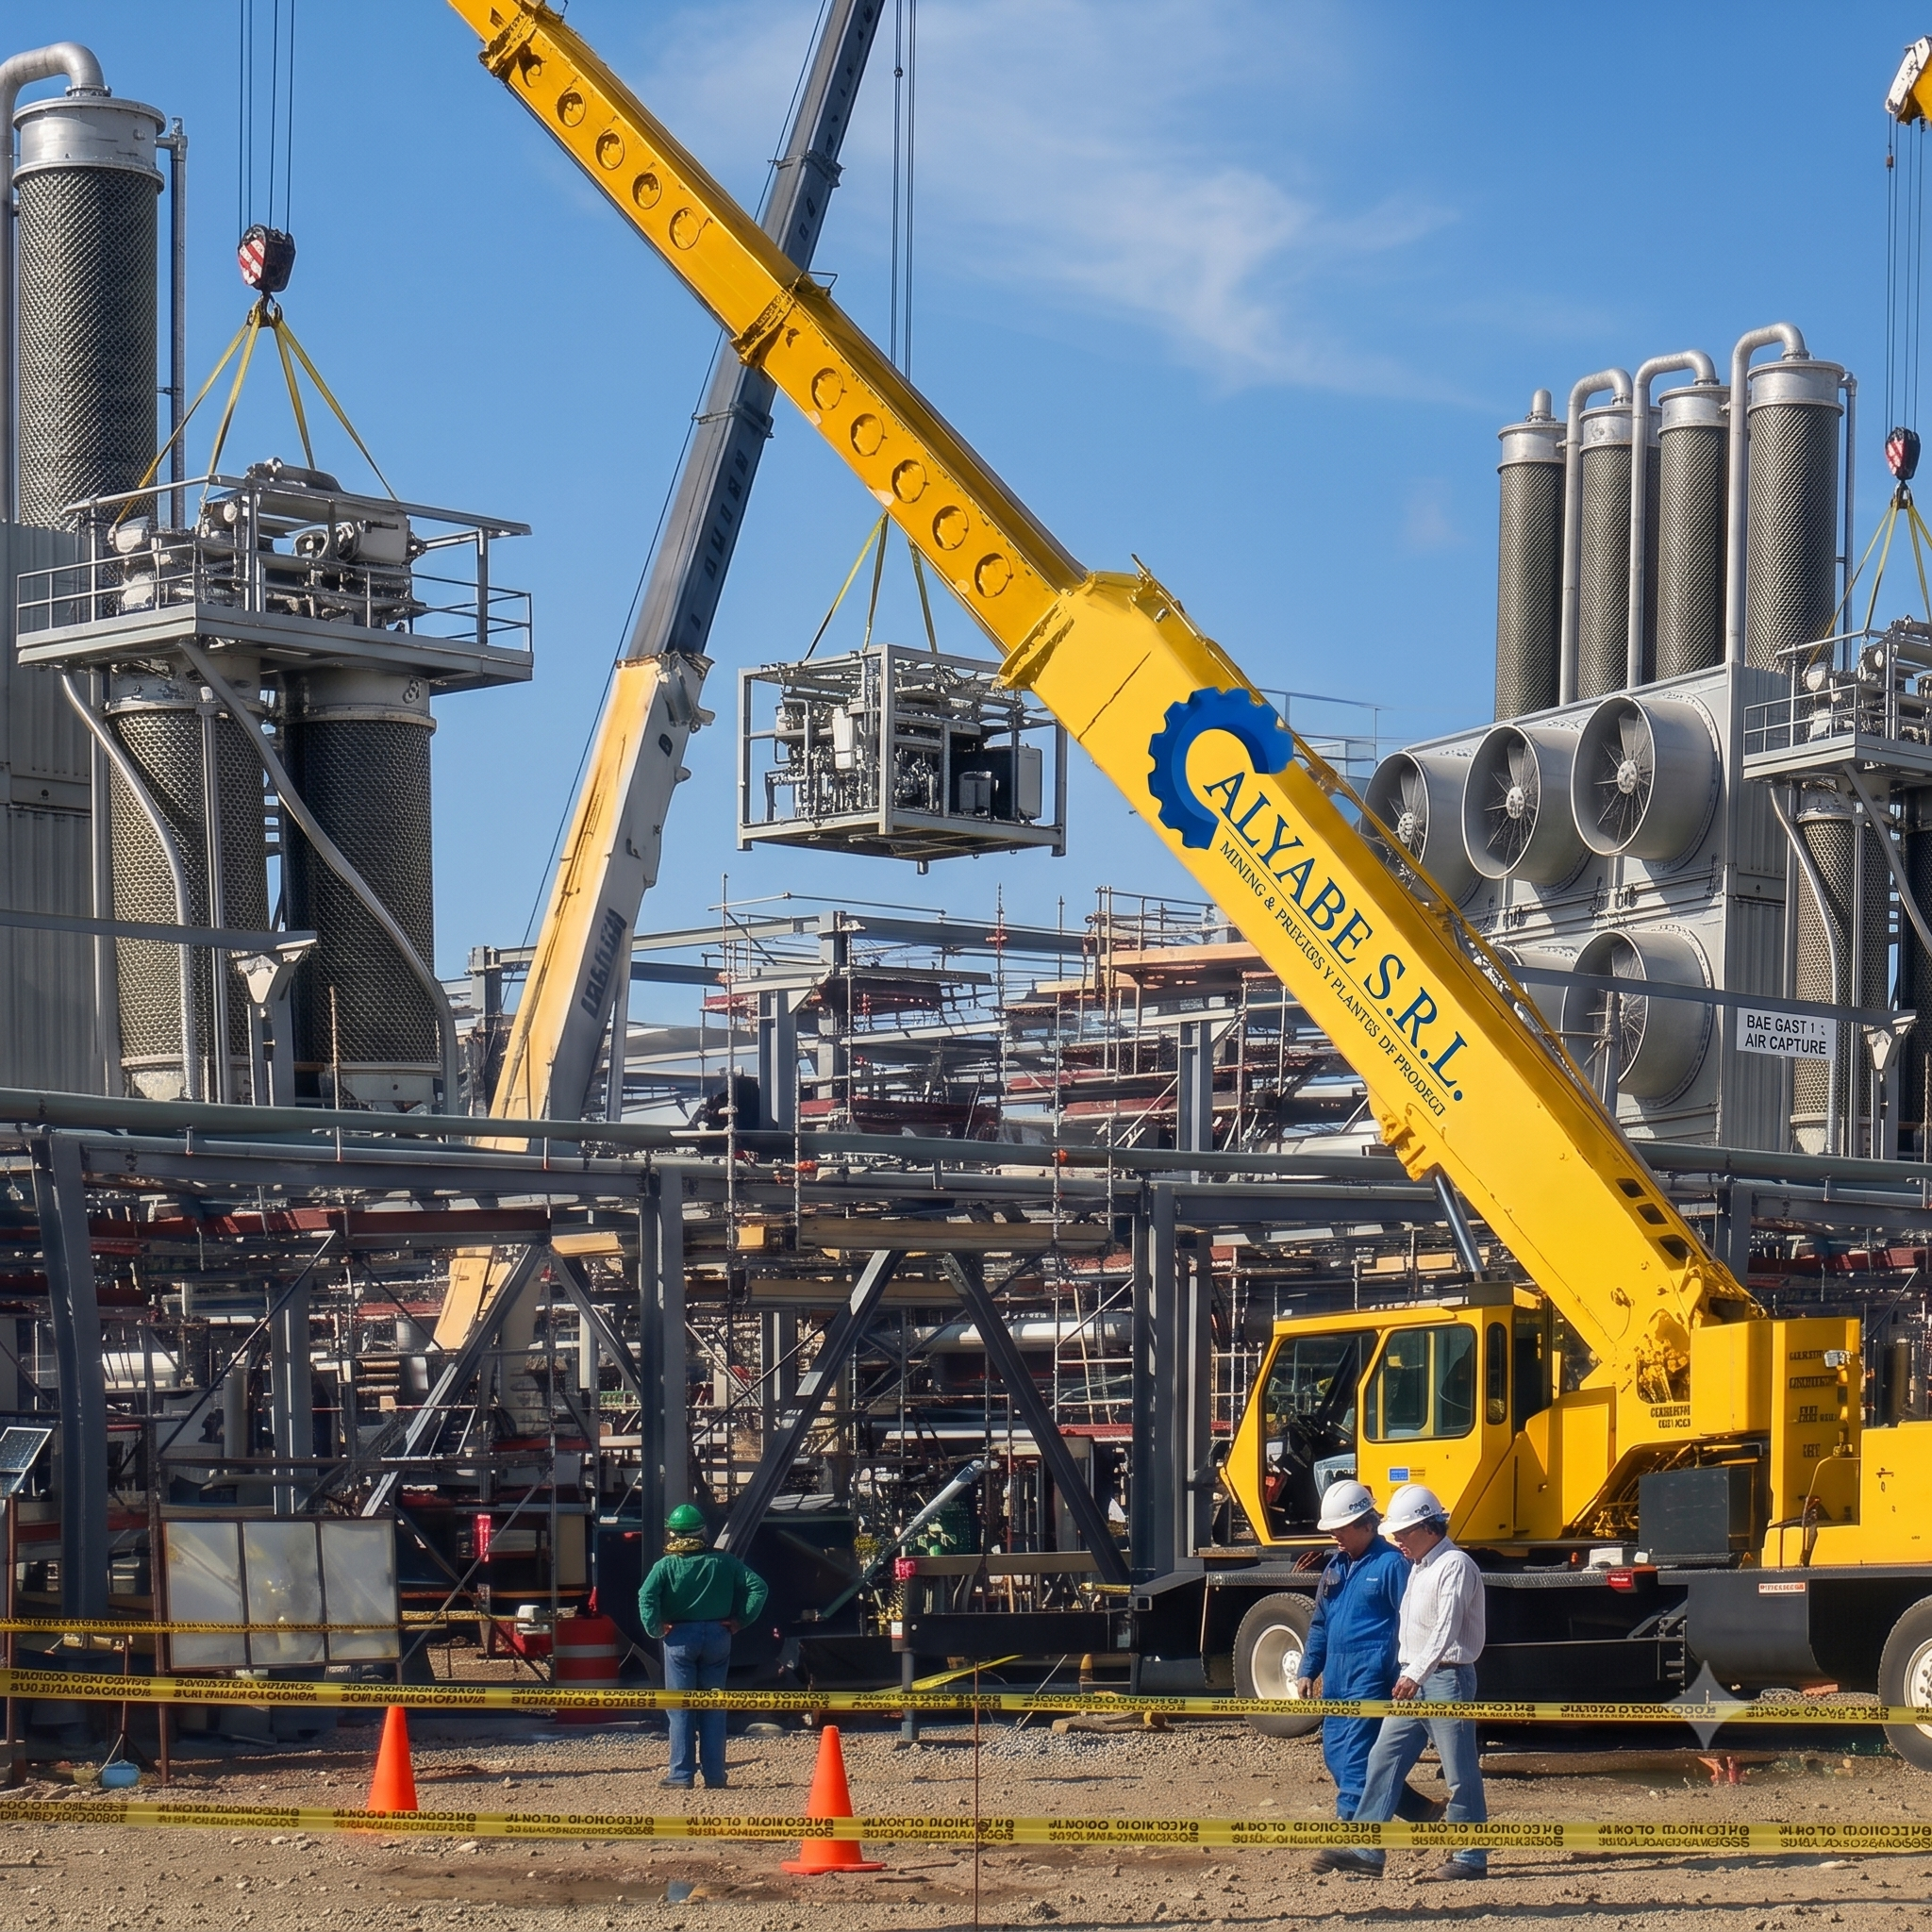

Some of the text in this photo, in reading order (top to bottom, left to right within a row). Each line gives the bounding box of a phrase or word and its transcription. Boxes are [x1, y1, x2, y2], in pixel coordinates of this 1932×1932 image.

[1220, 841, 1266, 897] MINING
[1264, 896, 1275, 911] &
[1324, 965, 1335, 980] Y
[1363, 954, 1467, 1102] S.R.L.
[1744, 1032, 1827, 1055] AIR CAPTURE
[1747, 1014, 1772, 1031] BAE
[1775, 1018, 1807, 1035] GAST
